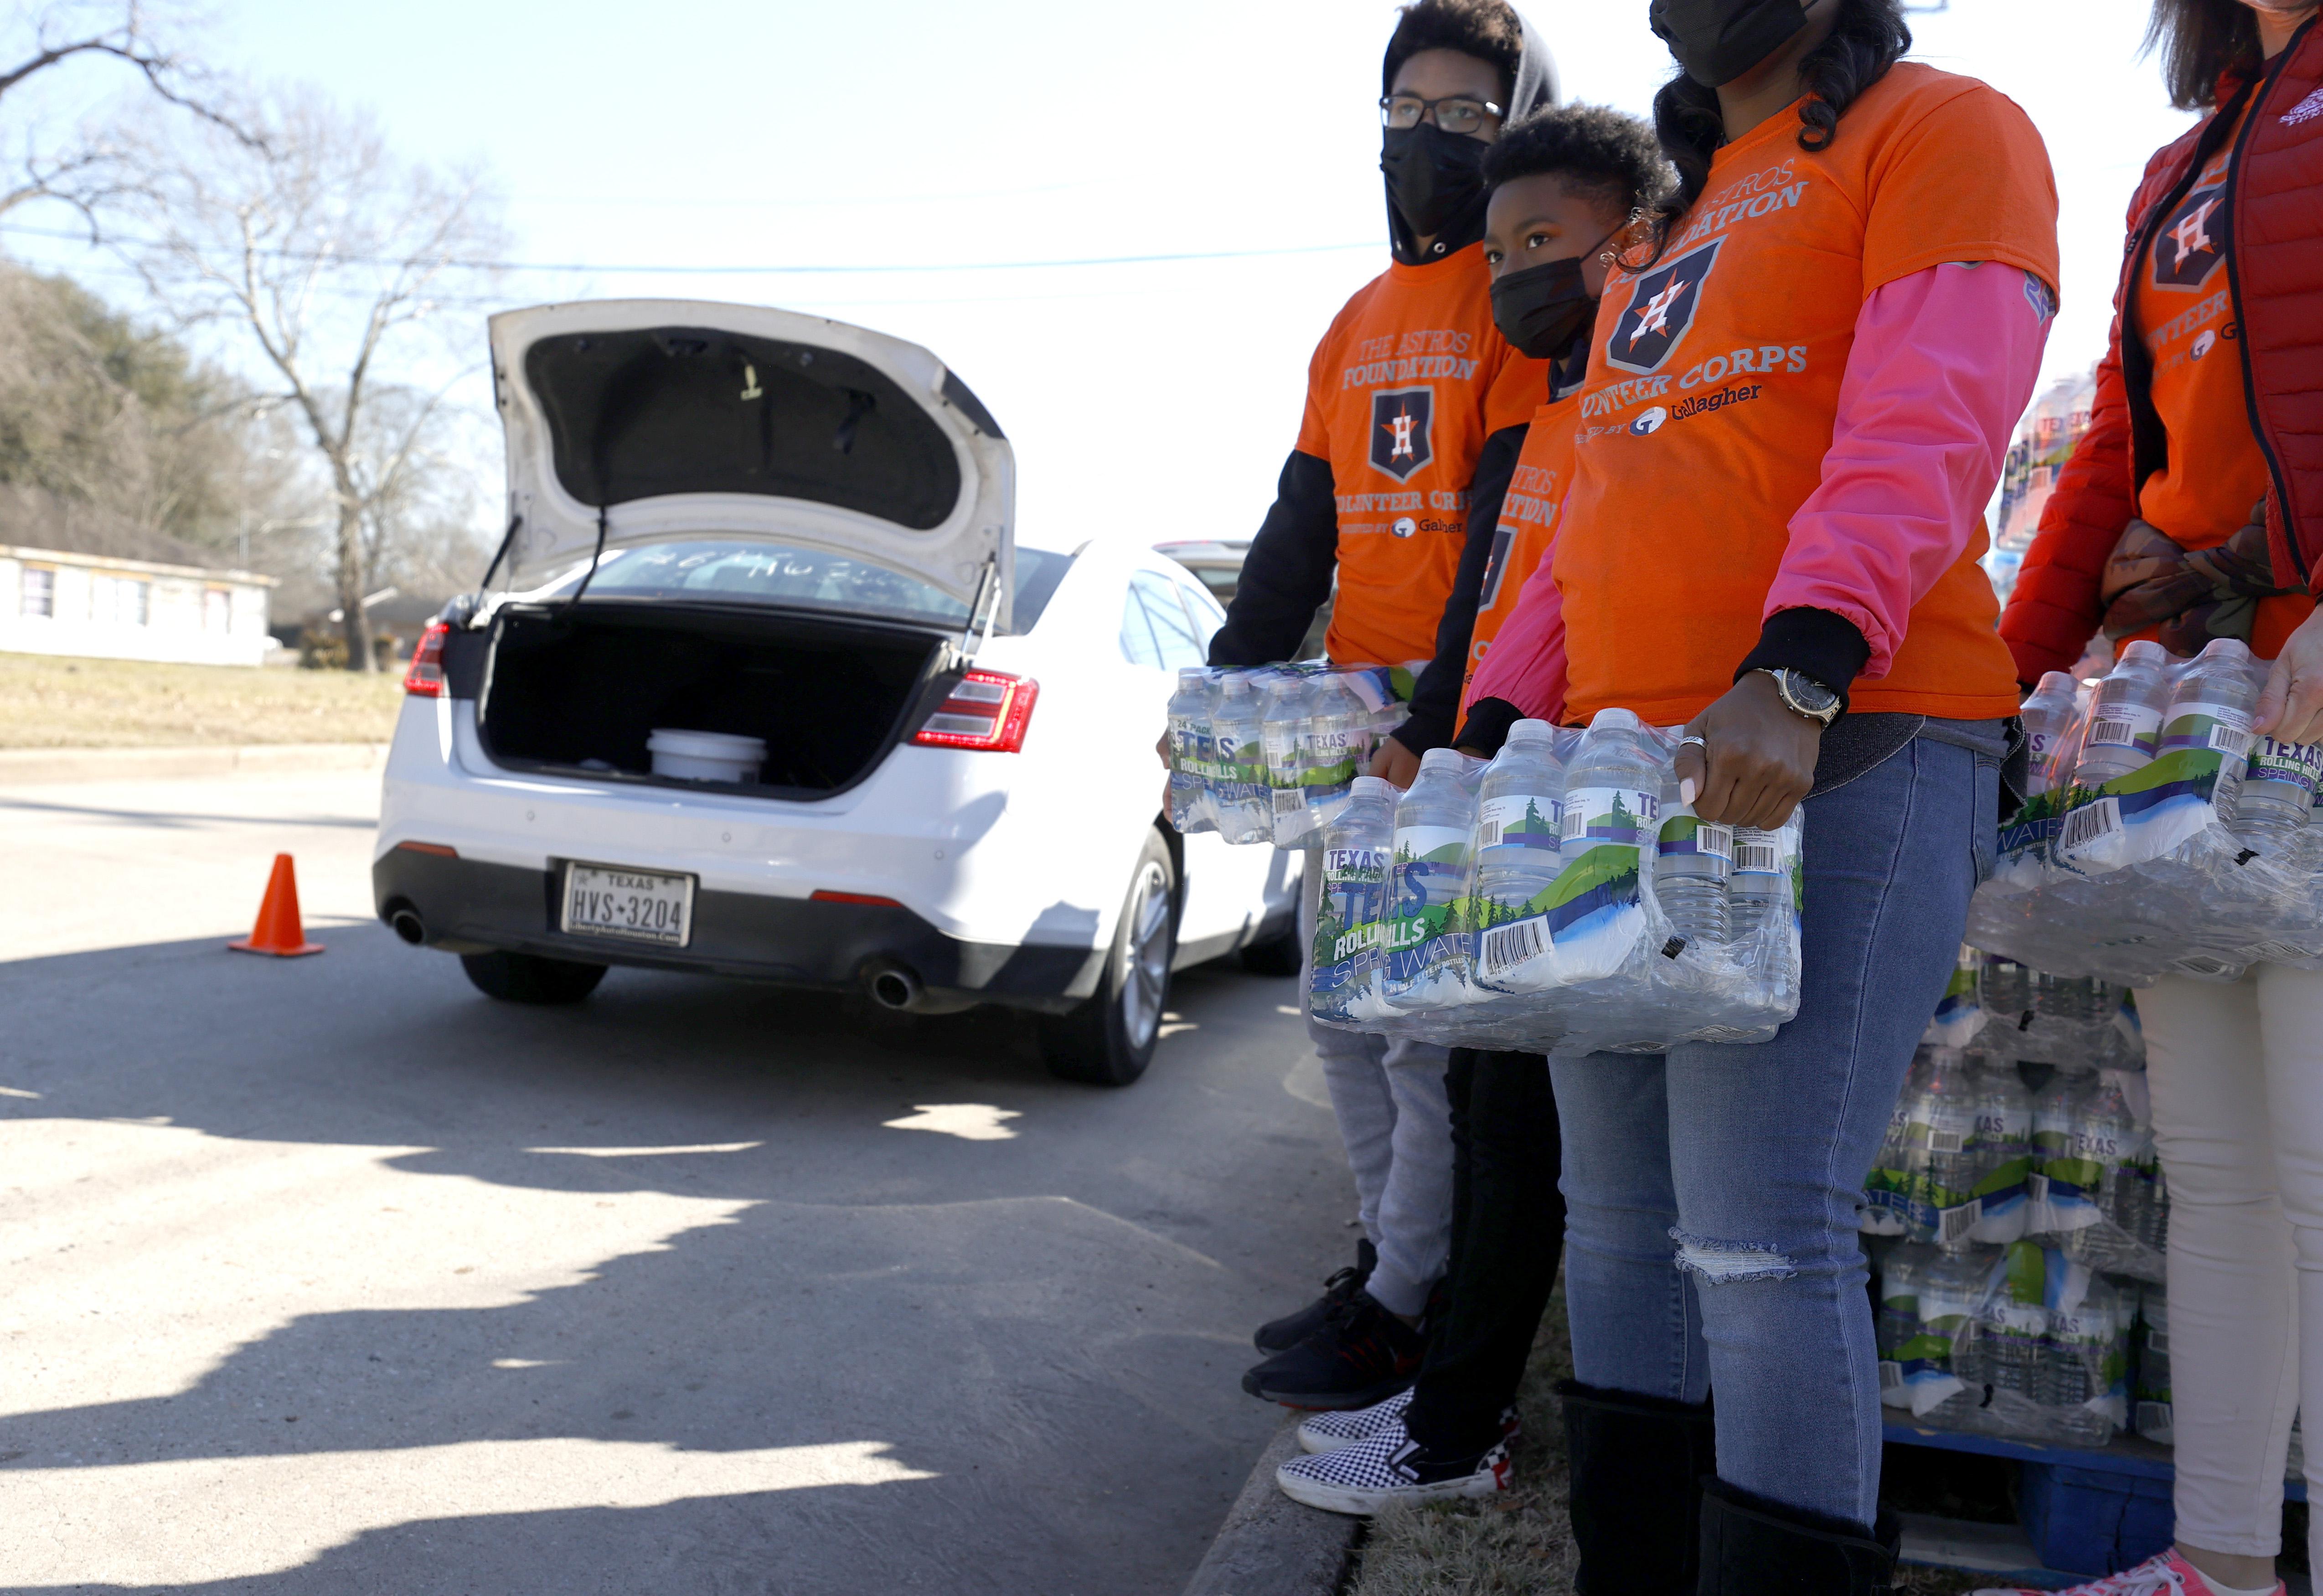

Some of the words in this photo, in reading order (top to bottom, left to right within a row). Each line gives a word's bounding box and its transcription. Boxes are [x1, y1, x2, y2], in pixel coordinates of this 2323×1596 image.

[2174, 197, 2215, 263] H
[1630, 279, 1684, 341] H
[1357, 335, 1394, 362] THE
[1395, 329, 1472, 356] ASTROS
[1342, 355, 1479, 390] FOUNDATION
[1581, 375, 1673, 418] UNTEER
[1679, 345, 1807, 389] CORPS
[1671, 384, 1762, 420] Gallagher
[1392, 414, 1413, 455] H
[1307, 733, 1347, 749] TEXAS
[2265, 736, 2322, 770] TEXAS
[2258, 767, 2309, 788] SPRING
[2260, 757, 2301, 772] ROLLING
[2302, 764, 2319, 782] HILLS
[1330, 850, 1384, 870] TEXAS
[608, 874, 654, 891] TEXAS
[1400, 932, 1471, 978] WATE
